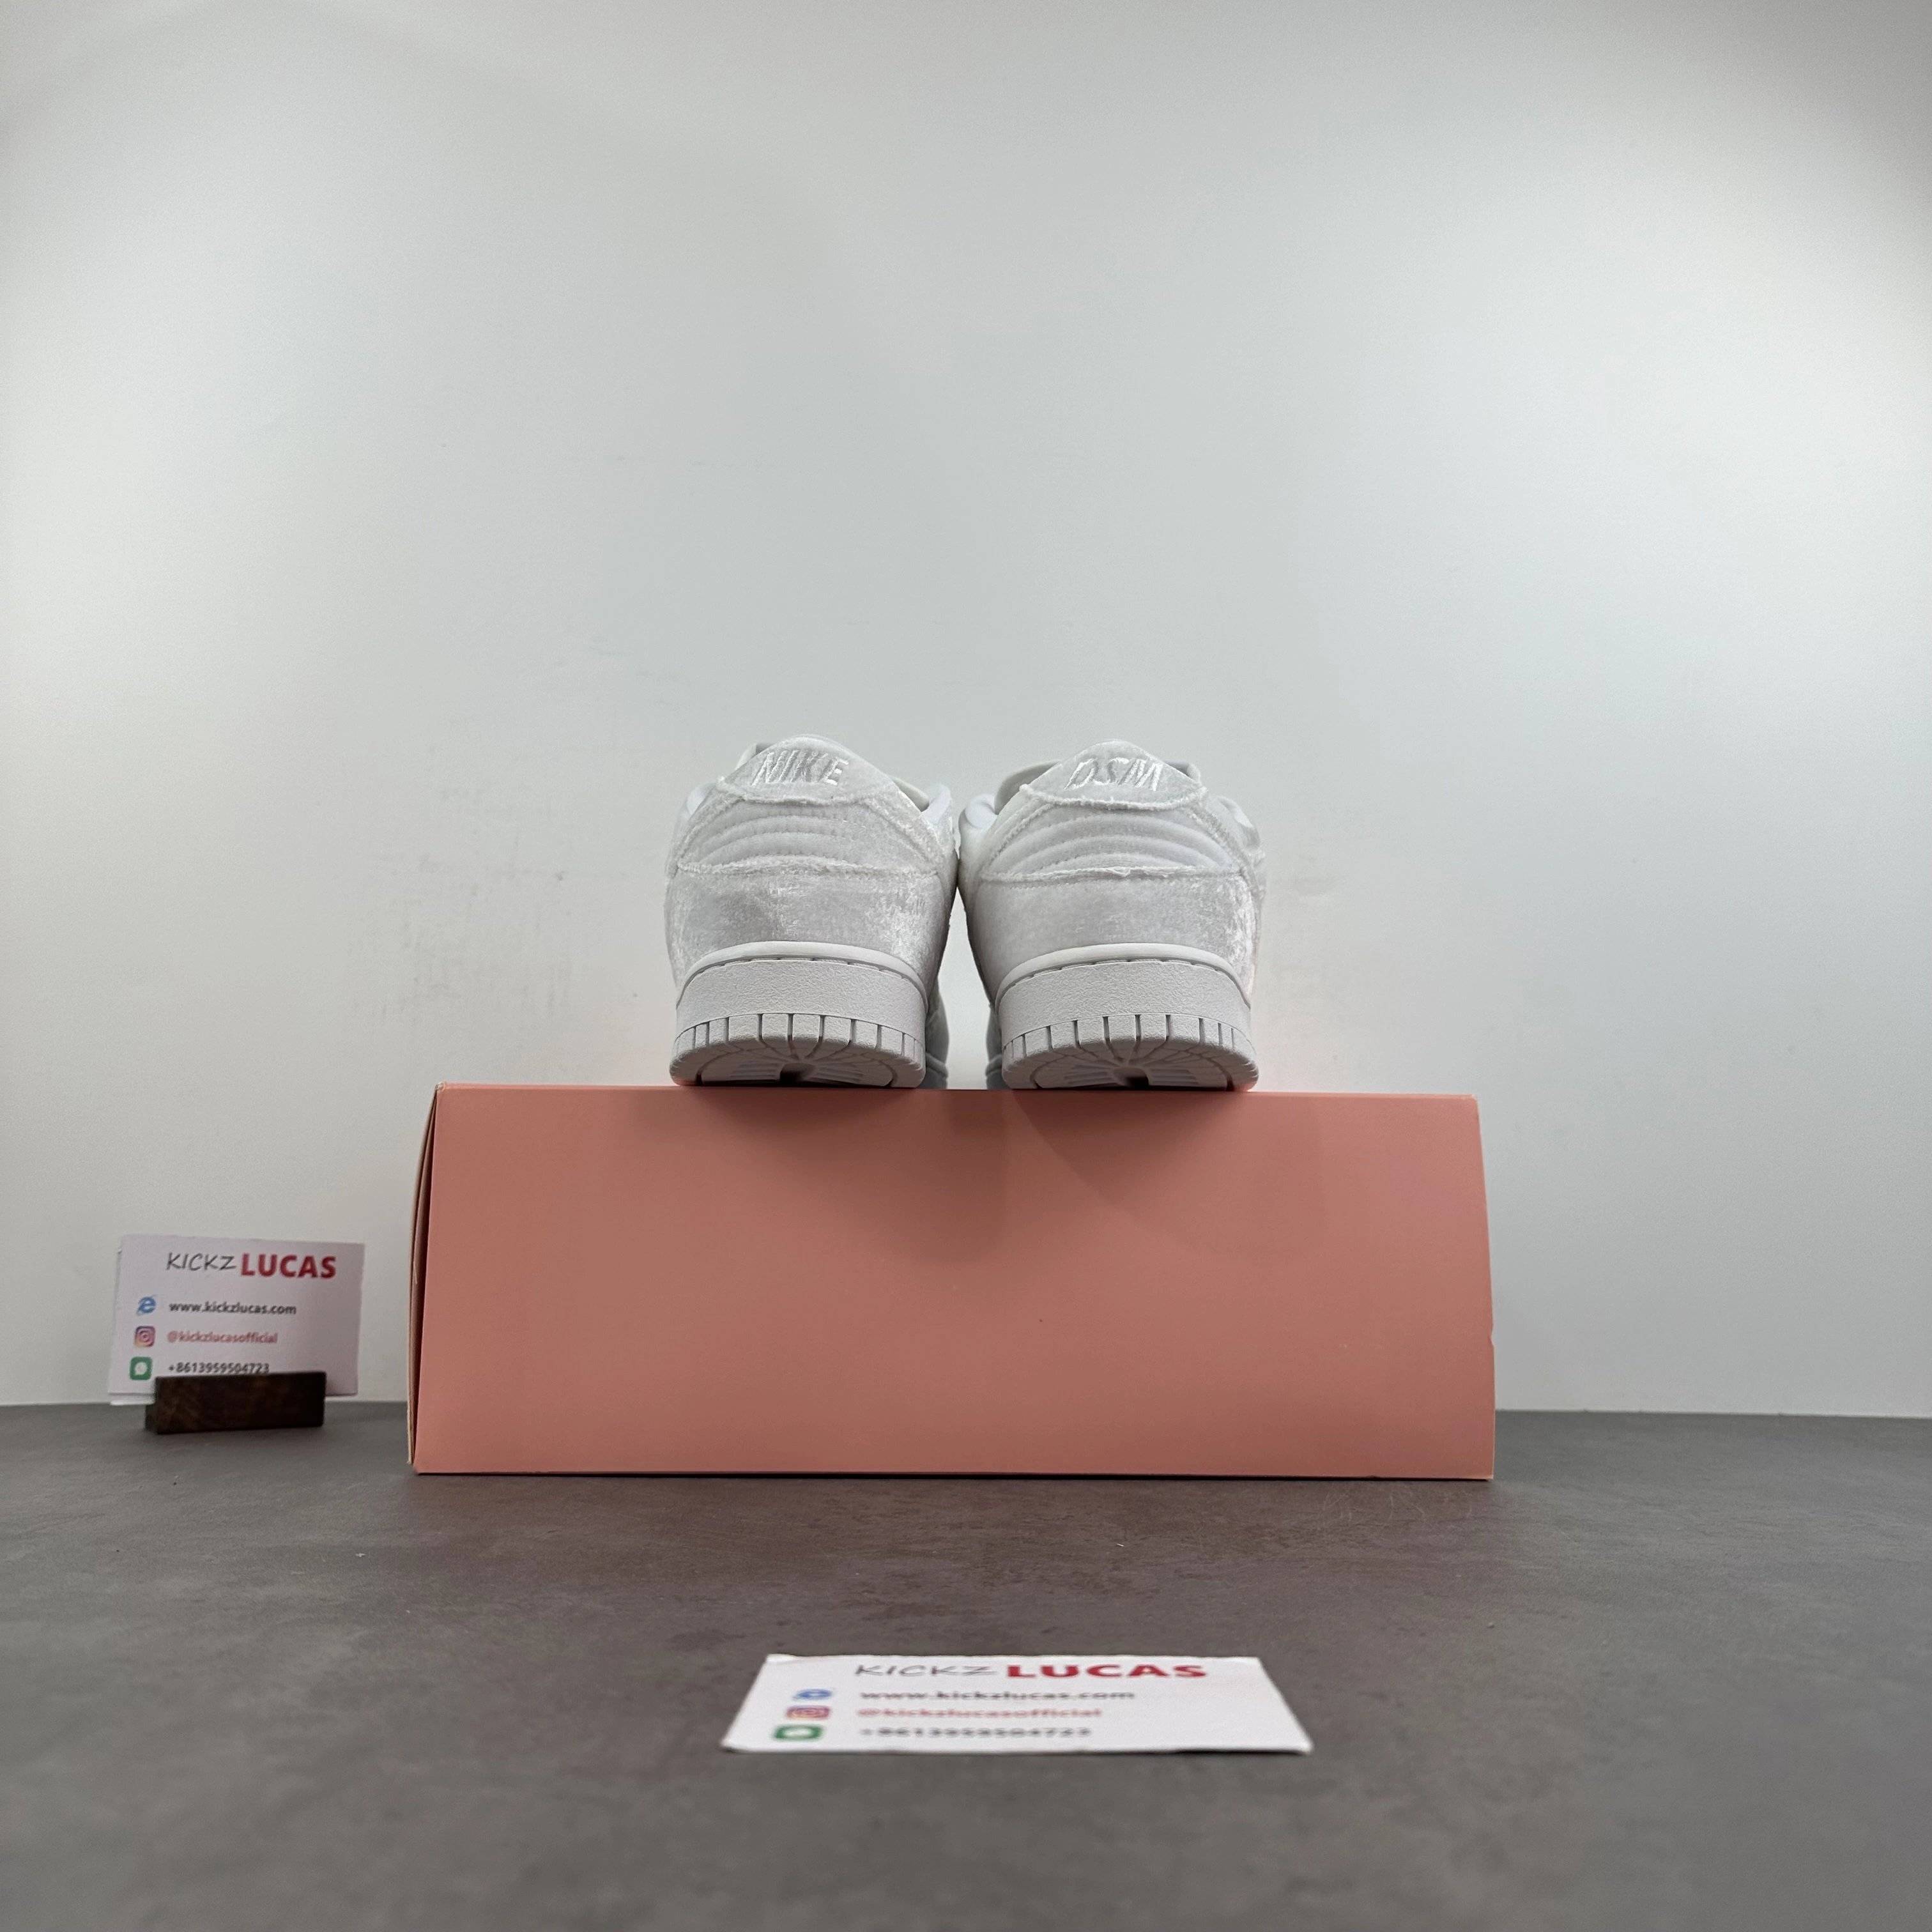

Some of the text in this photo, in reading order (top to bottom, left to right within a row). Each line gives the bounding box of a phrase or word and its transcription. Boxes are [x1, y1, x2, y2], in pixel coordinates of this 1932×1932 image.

[750, 749, 848, 786] NIKE
[1064, 757, 1163, 791] DSM
[167, 1252, 336, 1278] KICKZ LUCAS
[169, 1301, 297, 1315] www.kickzlucas.com
[167, 1331, 278, 1344] @kickzlucasofficial
[855, 1664, 1206, 1678] KICKZ LUCAS
